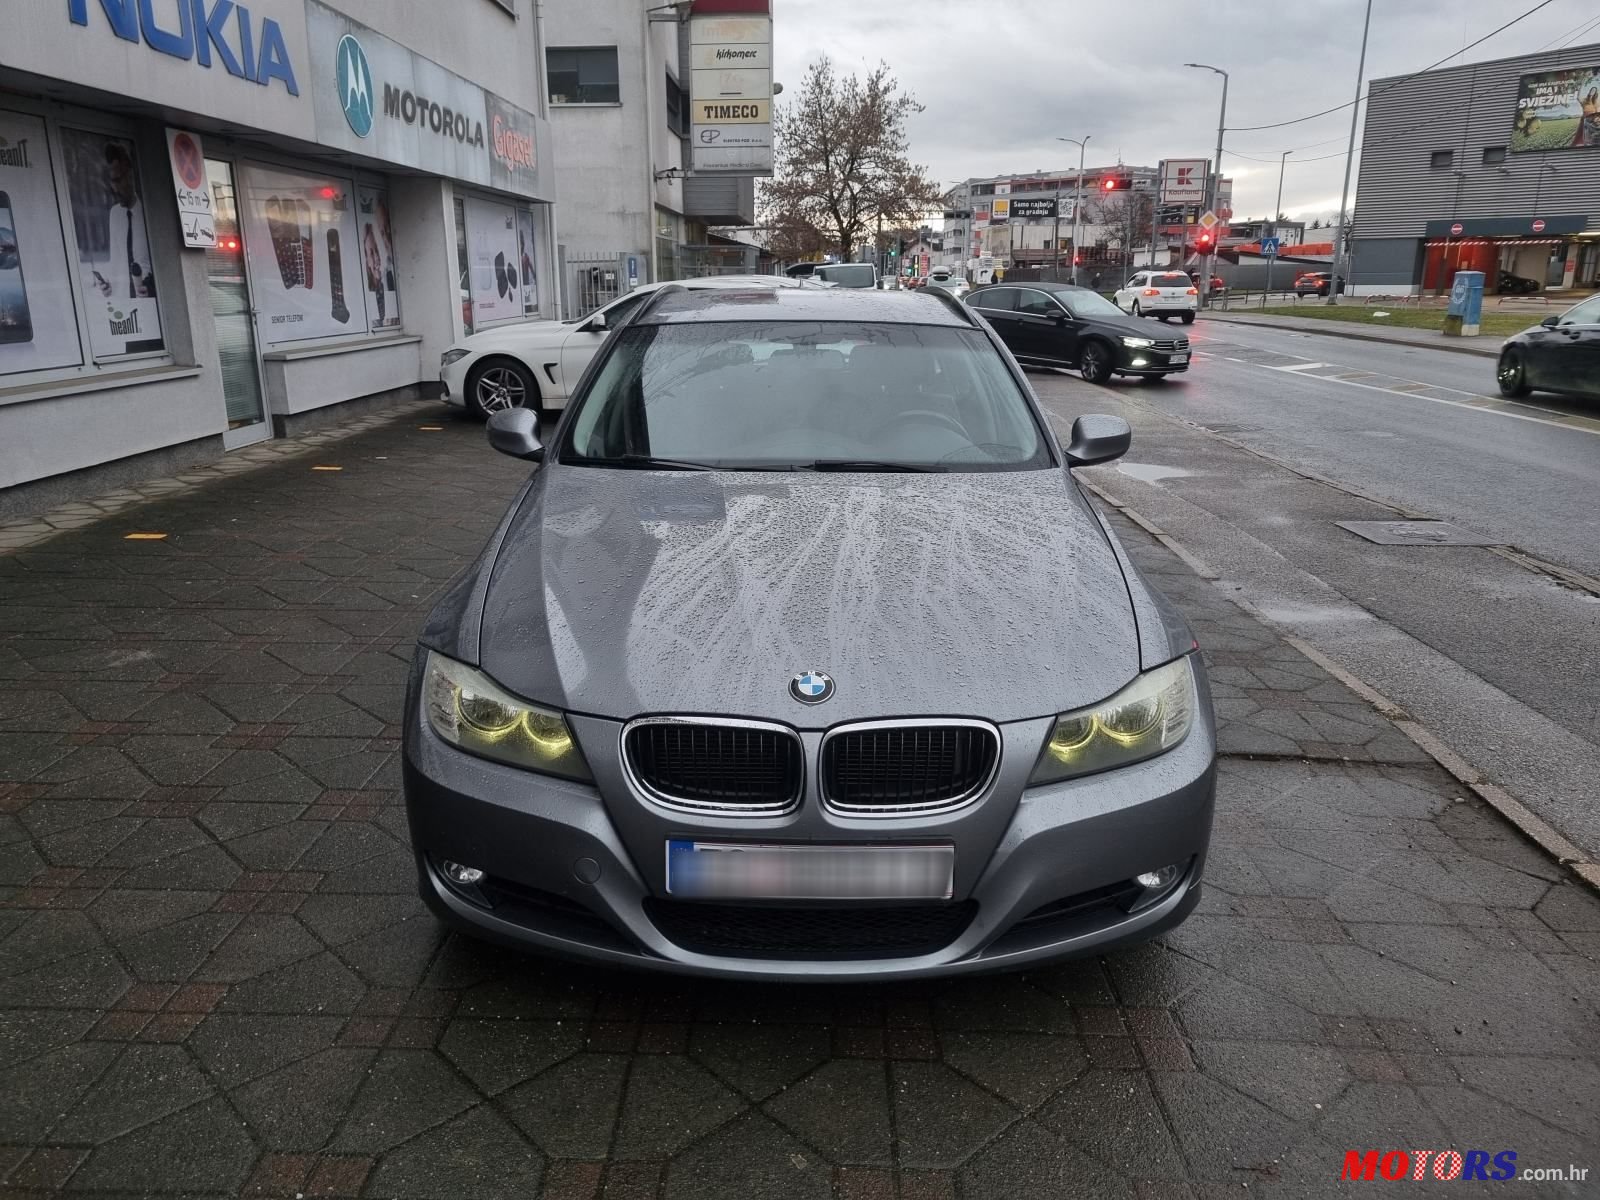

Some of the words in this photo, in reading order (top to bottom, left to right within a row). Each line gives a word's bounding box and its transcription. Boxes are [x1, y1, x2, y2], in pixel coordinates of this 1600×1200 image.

[716, 49, 758, 60] kirkomerc
[383, 82, 484, 148] MOTOROLA
[704, 105, 759, 119] TIMECO
[0, 138, 29, 169] eanIT
[493, 114, 536, 172] Gigaset
[1013, 200, 1030, 208] Samo
[1030, 200, 1054, 209] najbolje
[109, 308, 139, 336] meanIT
